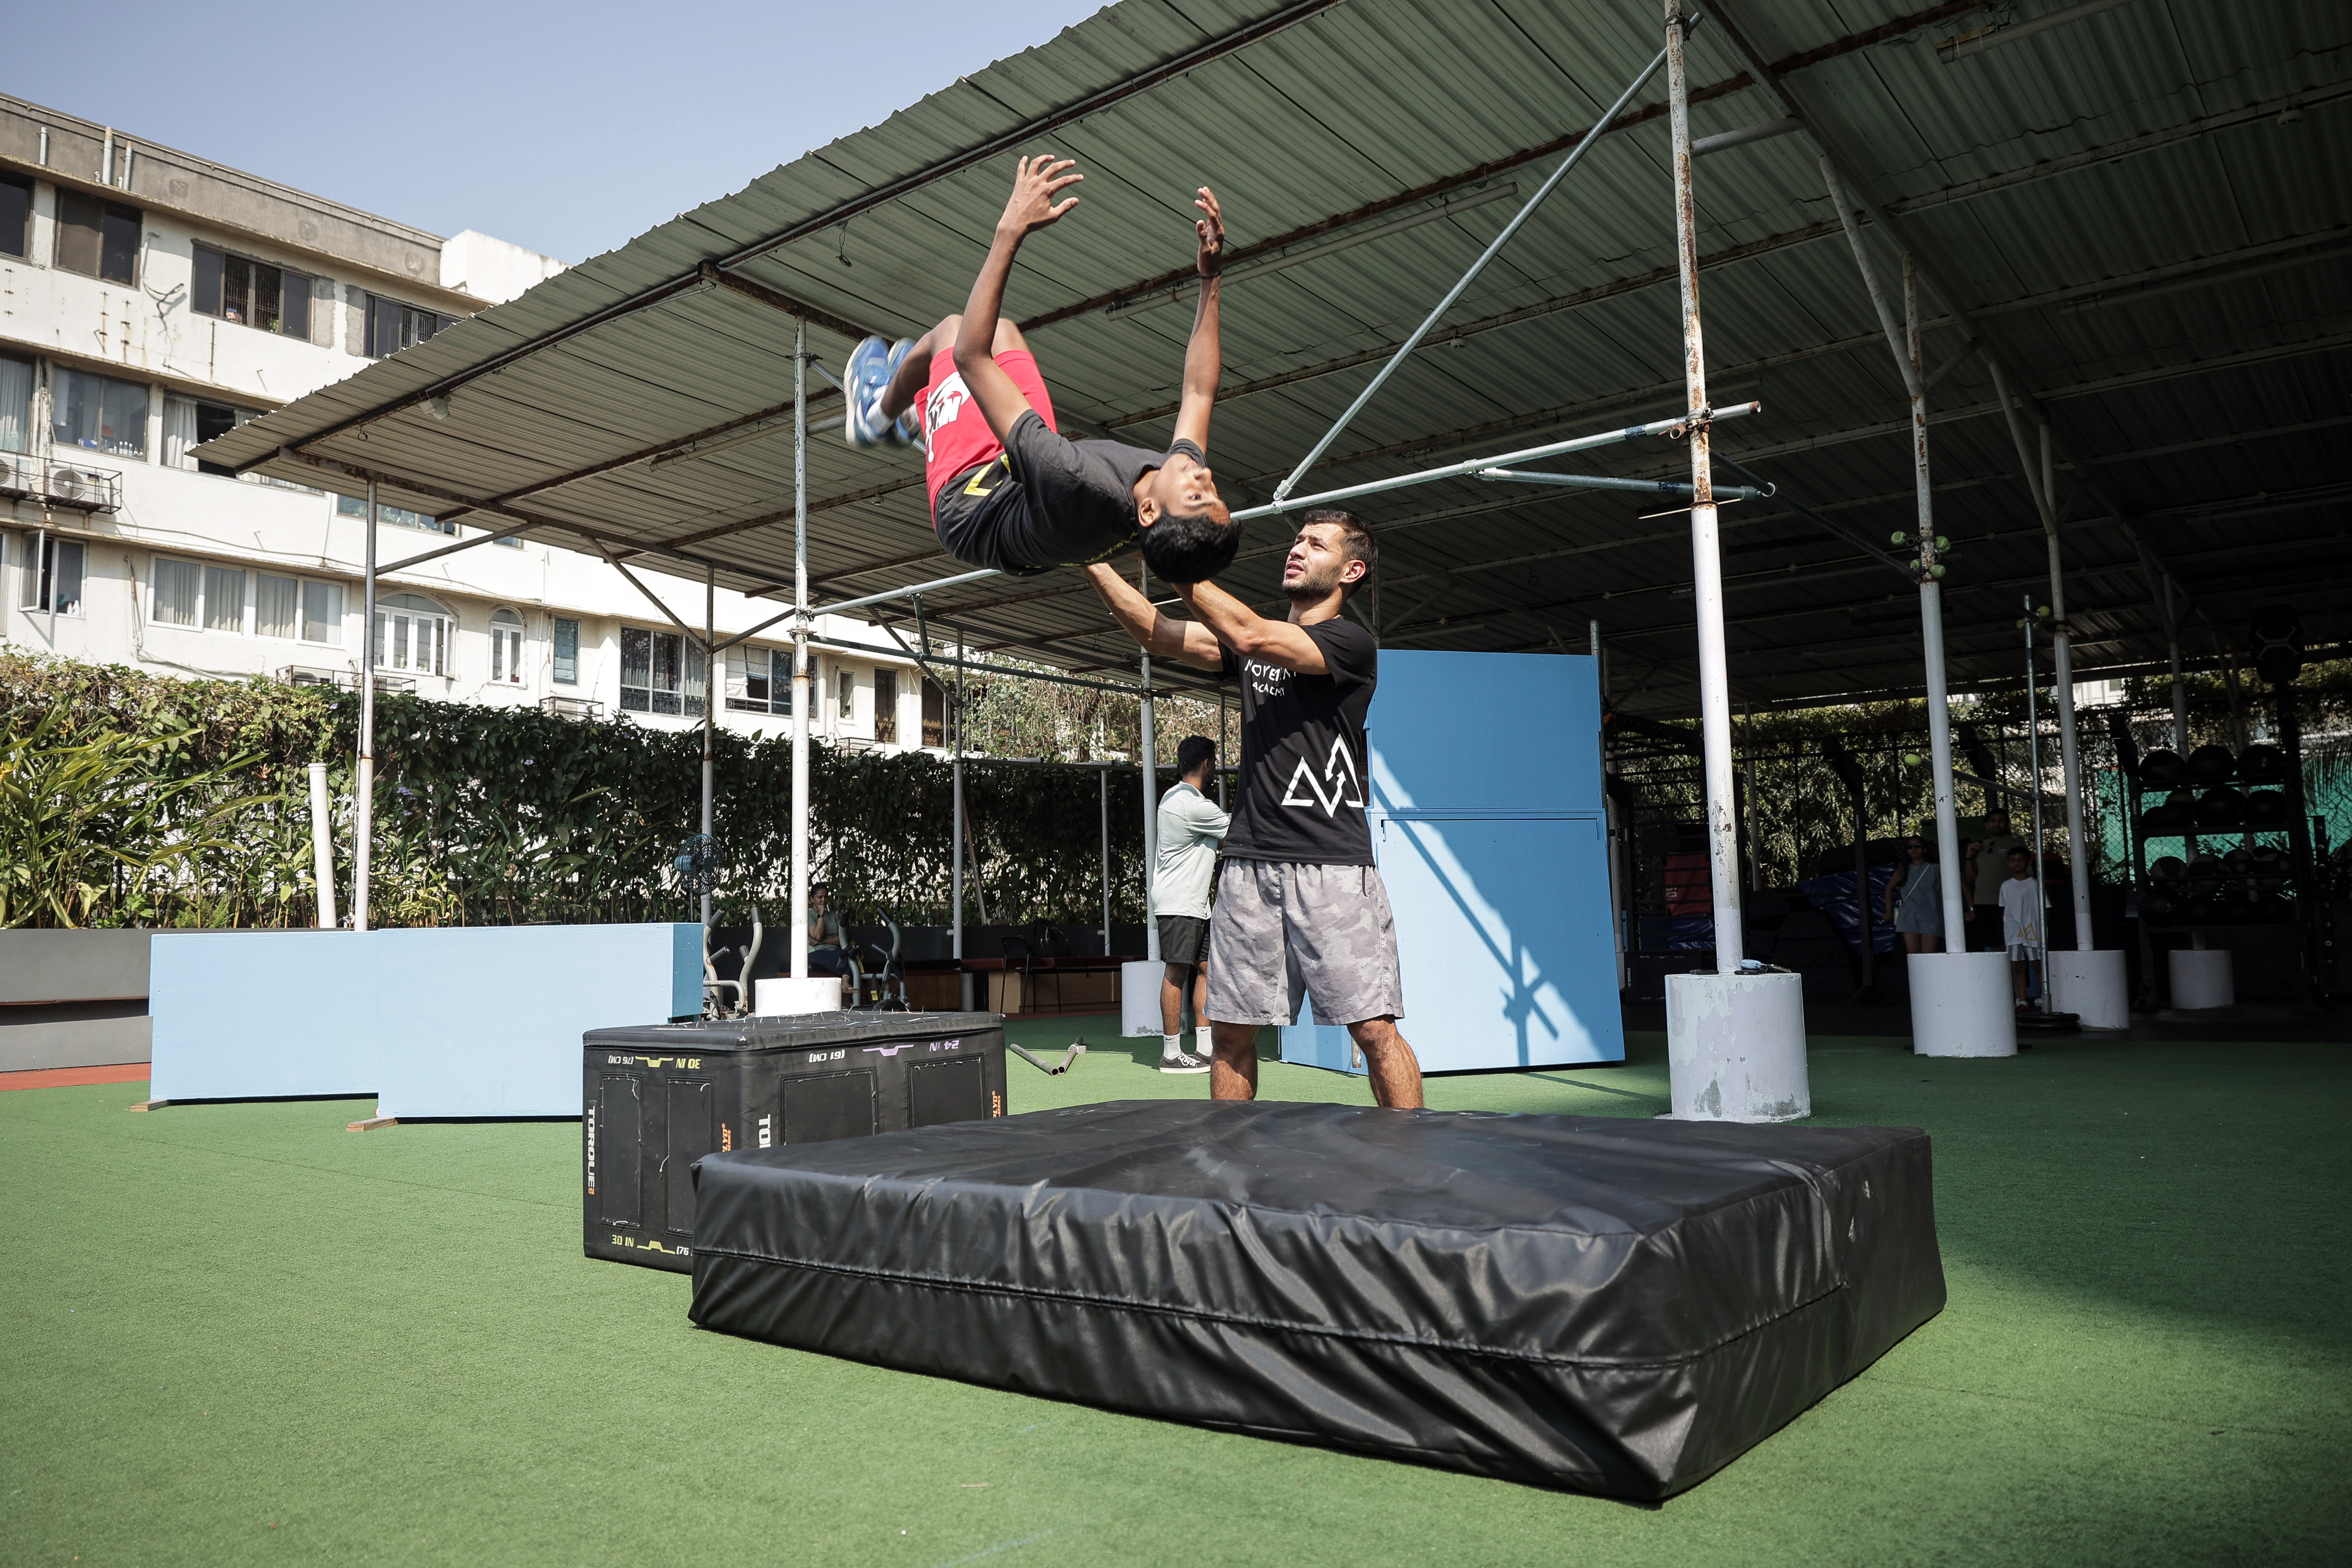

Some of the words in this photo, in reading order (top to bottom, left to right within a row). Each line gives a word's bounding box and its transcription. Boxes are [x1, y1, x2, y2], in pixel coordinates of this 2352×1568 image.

[929, 1042, 940, 1051] IN
[944, 1040, 959, 1050] 24
[608, 1055, 621, 1064] CM)
[808, 1052, 827, 1063] CM)
[830, 1050, 845, 1060] (61
[622, 1056, 634, 1065] (76
[675, 1058, 686, 1069] IN
[688, 1059, 701, 1069] 30
[759, 1114, 771, 1148] TO
[611, 1234, 622, 1245] 30
[625, 1237, 634, 1247] IN
[676, 1246, 689, 1256] (76
